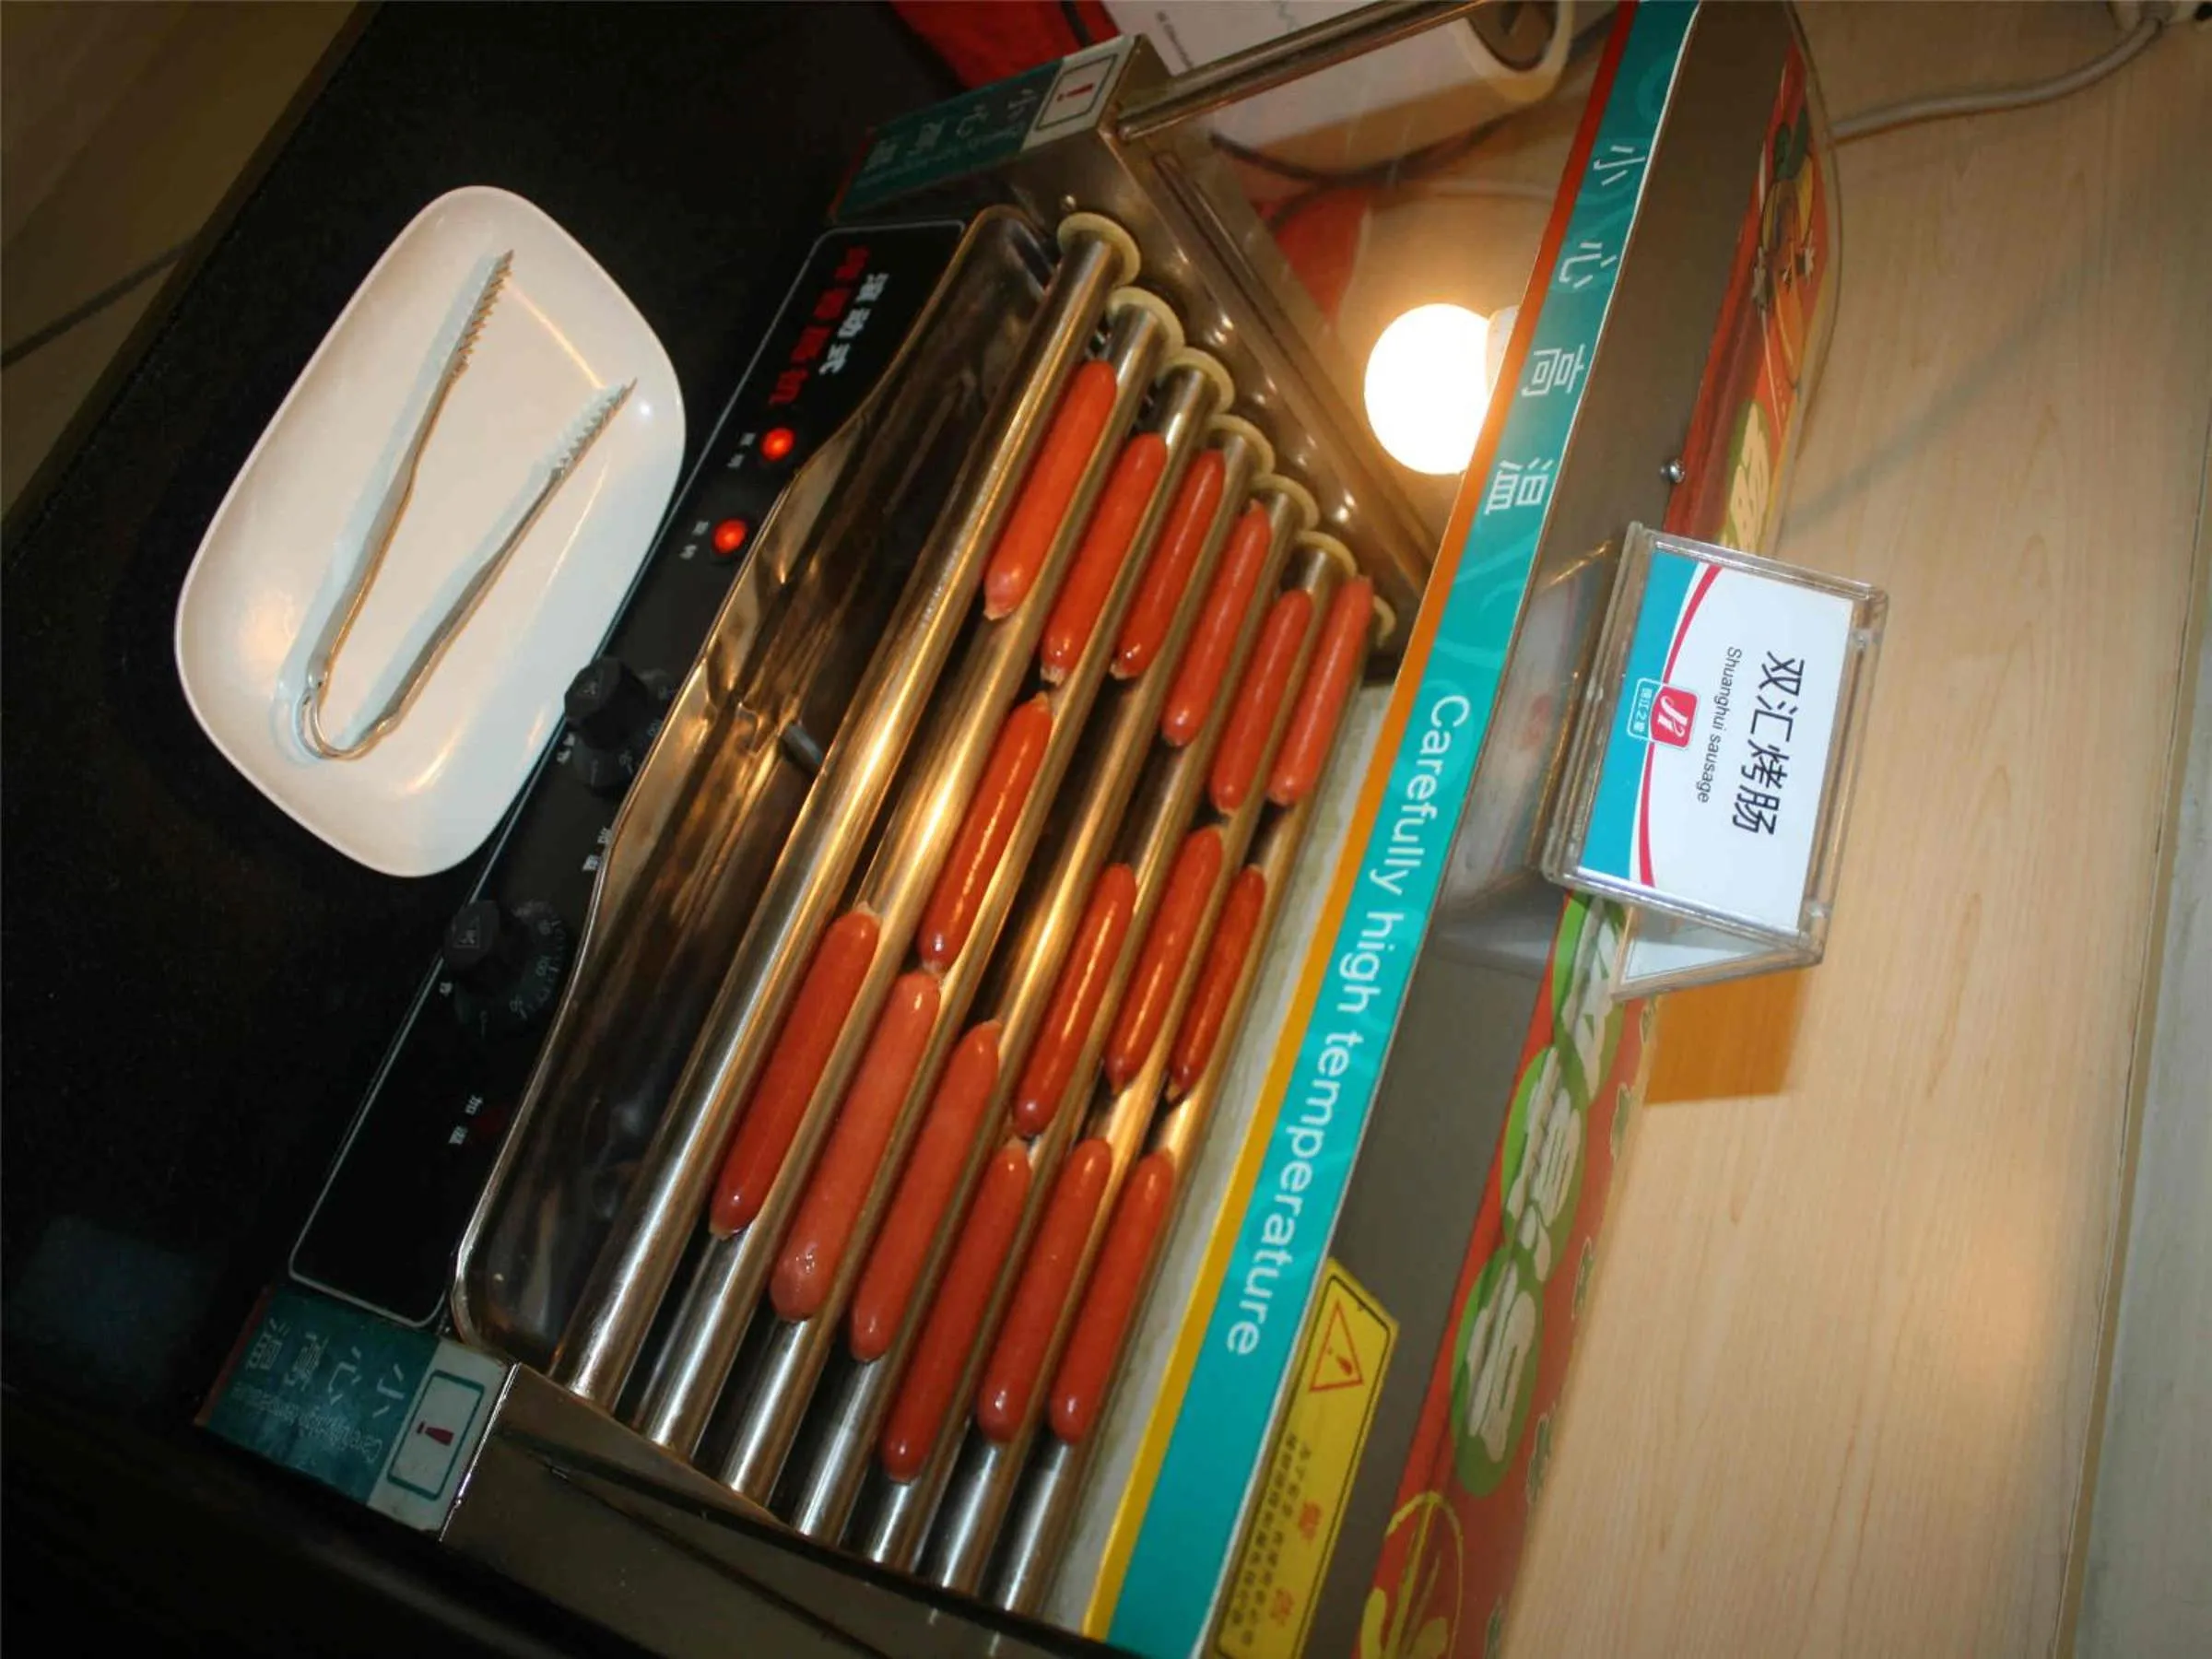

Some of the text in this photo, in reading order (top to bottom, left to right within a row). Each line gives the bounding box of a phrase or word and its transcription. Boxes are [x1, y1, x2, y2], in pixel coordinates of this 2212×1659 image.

[1484, 145, 1645, 515] 小心高温
[1370, 695, 1470, 895] Carefully
[1696, 646, 1743, 804] Shuanghui sausage
[1733, 651, 1806, 836] 双汇烤肠
[1340, 912, 1404, 1013] high
[1227, 1033, 1362, 1355] temperature
